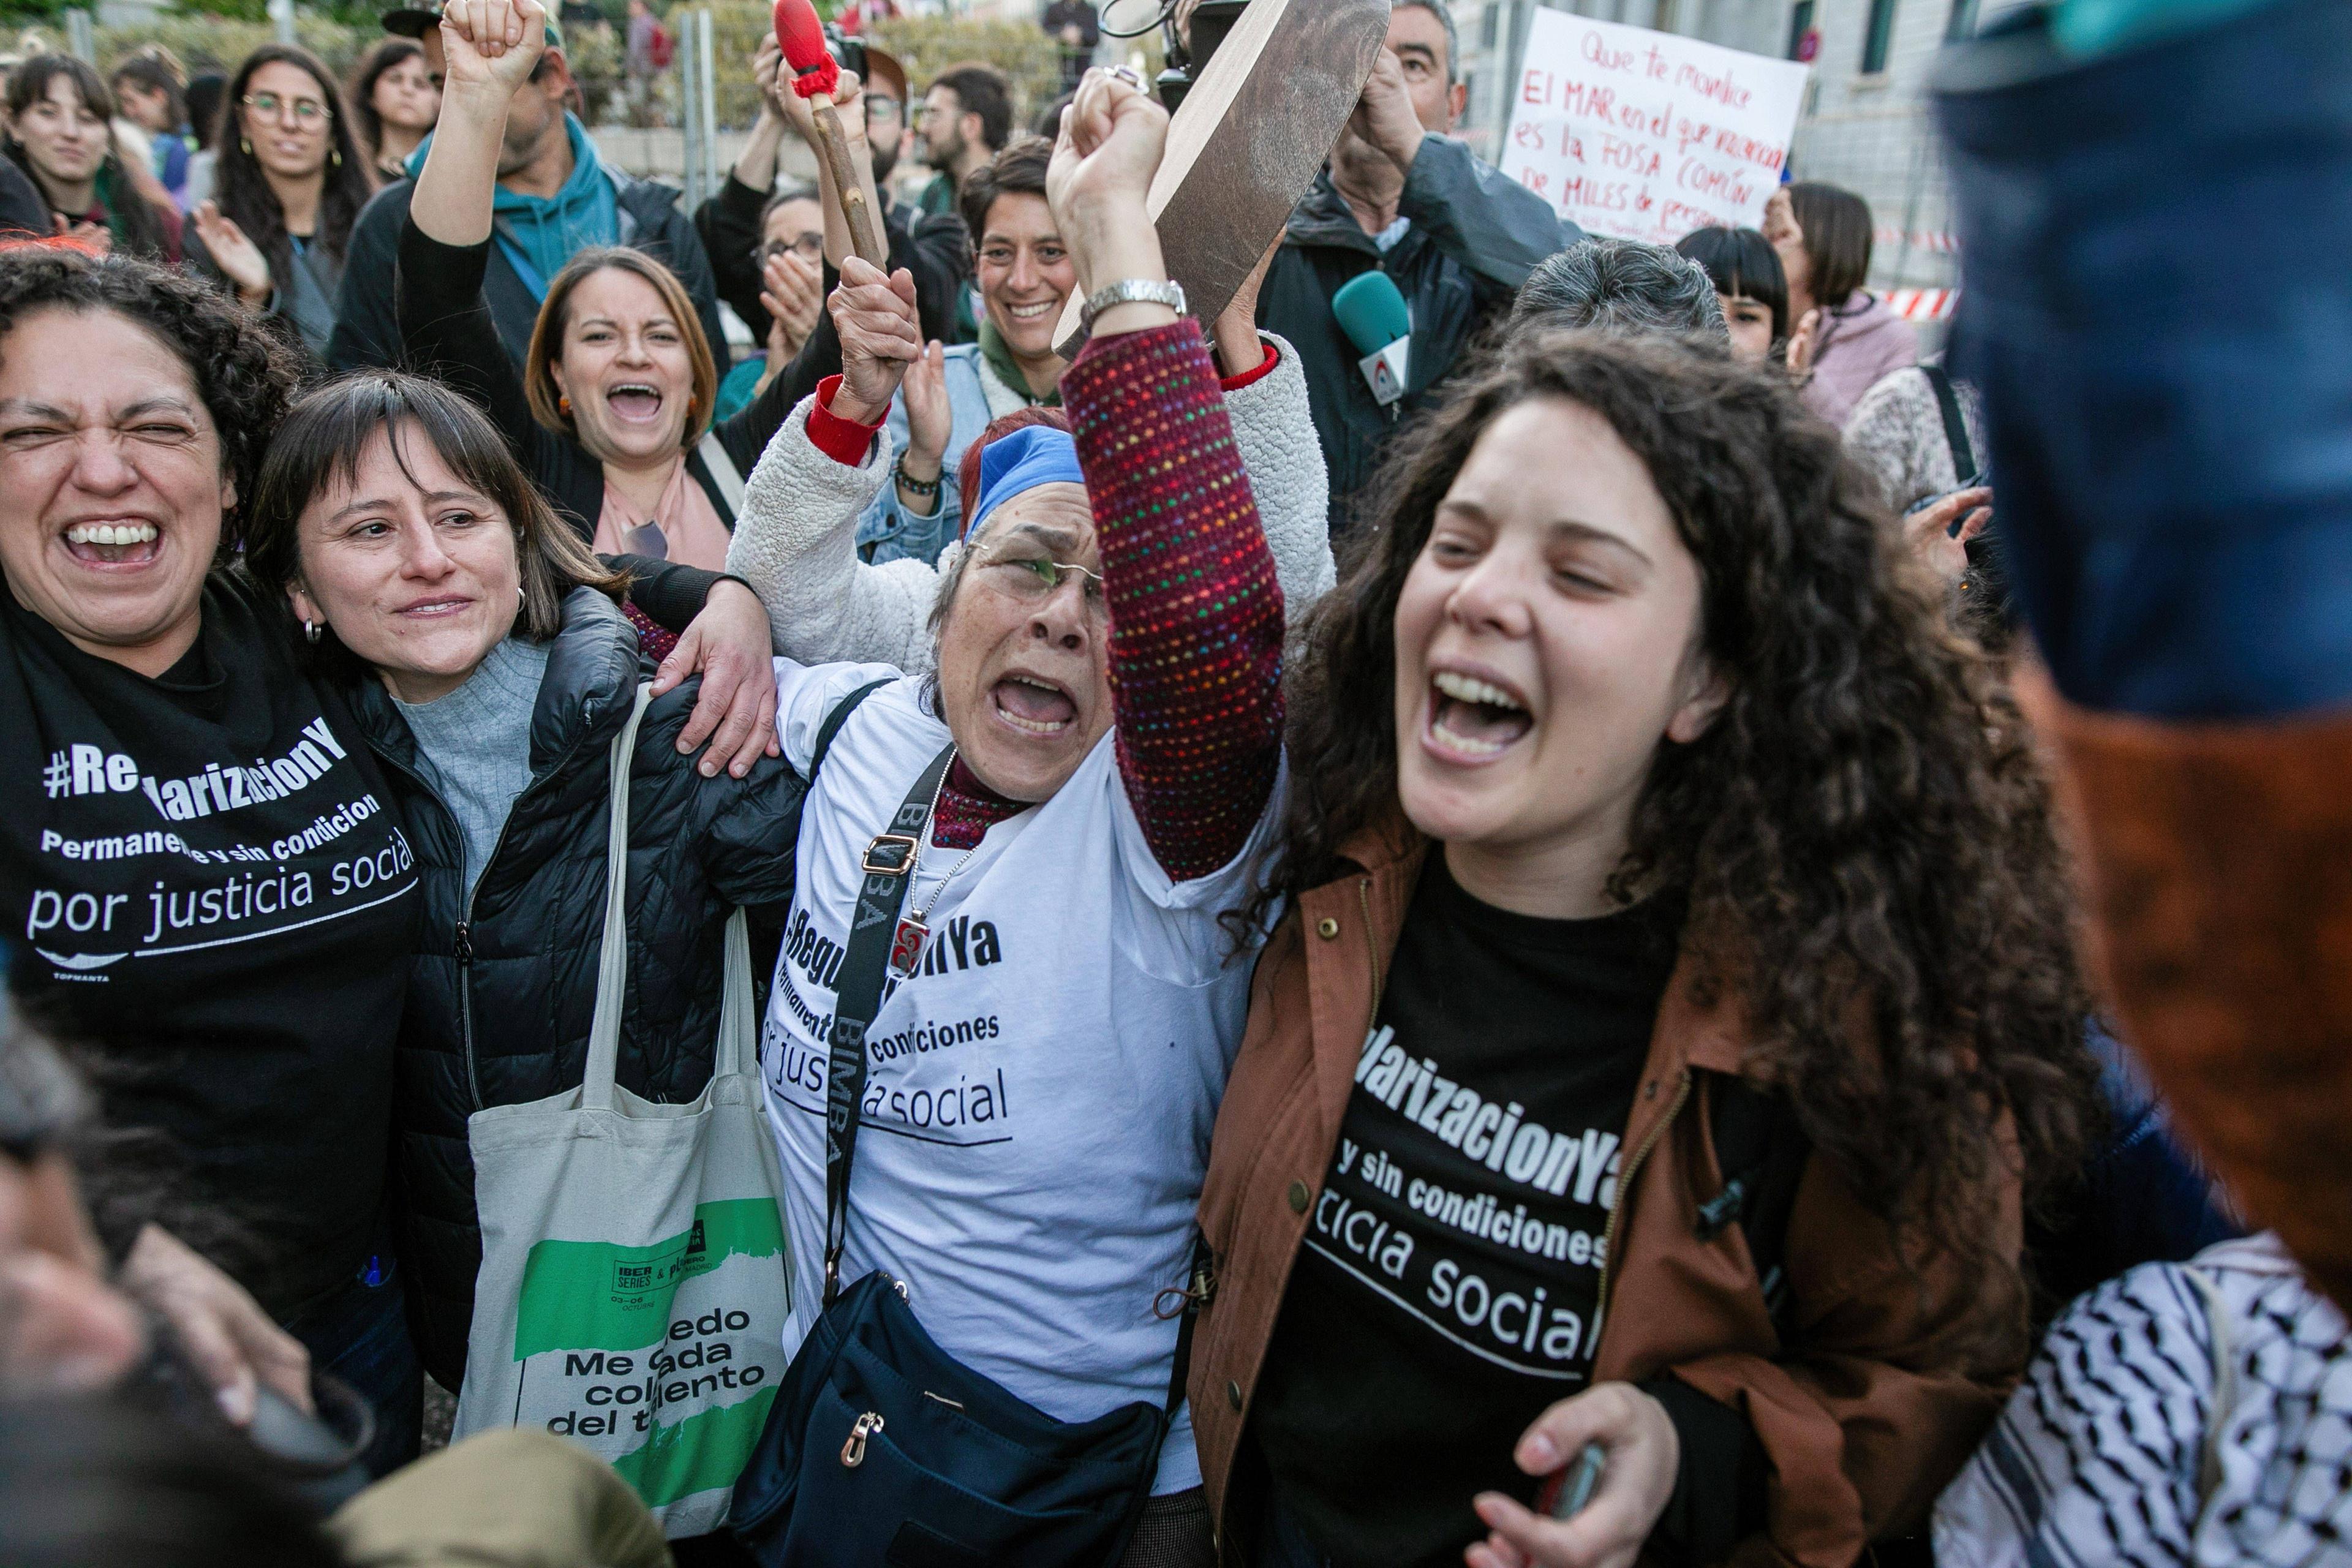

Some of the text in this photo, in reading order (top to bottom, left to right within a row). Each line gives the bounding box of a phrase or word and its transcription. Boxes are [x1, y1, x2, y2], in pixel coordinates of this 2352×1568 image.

[1581, 30, 1634, 74] Que
[1644, 42, 1668, 80] te
[1563, 80, 1616, 126] MAR
[1650, 102, 1674, 139] el
[228, 843, 271, 862] sin
[27, 827, 415, 943] por justicia social
[891, 1068, 1008, 1128] social
[1337, 1138, 1610, 1270] y sin condiciones
[617, 1275, 651, 1289] SERIES
[619, 1266, 652, 1276] IBER
[622, 1302, 655, 1311] OCTUBRE
[564, 1352, 634, 1377] Me
[546, 1411, 617, 1436] del
